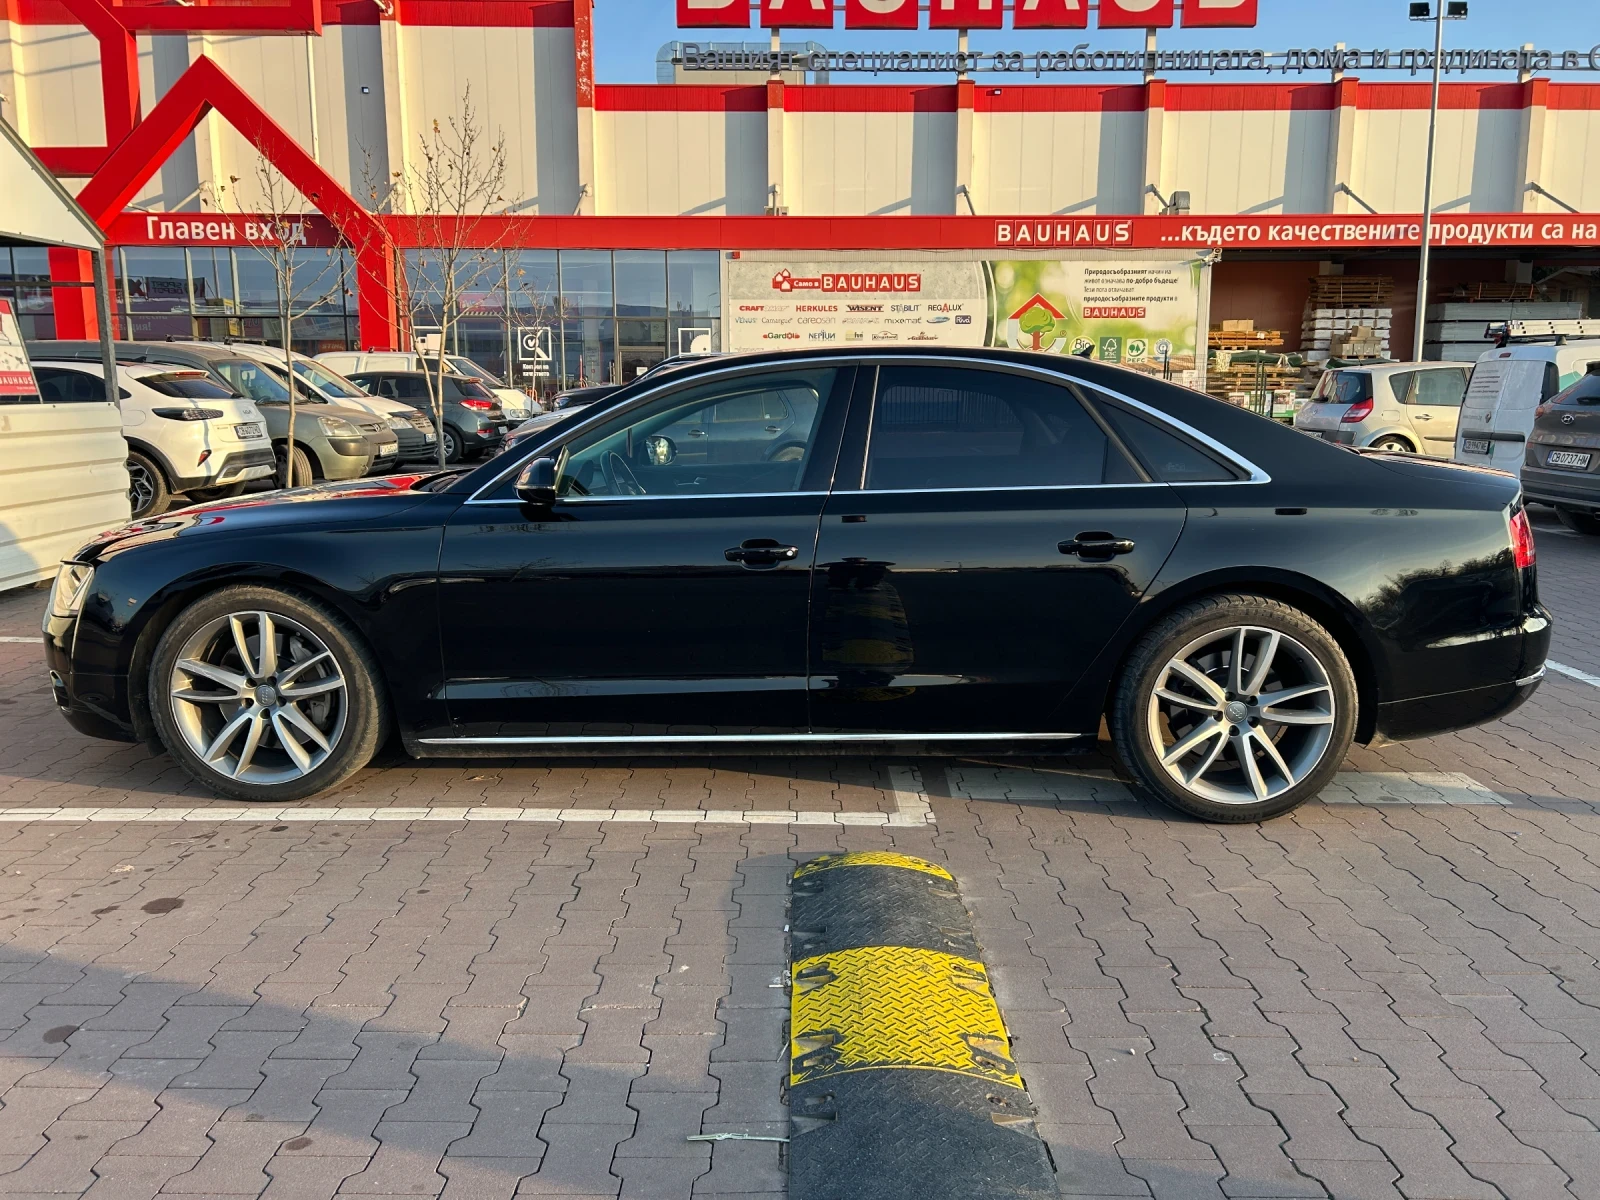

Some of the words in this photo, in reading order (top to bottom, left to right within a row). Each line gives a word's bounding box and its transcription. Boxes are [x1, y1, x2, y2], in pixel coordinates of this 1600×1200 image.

[682, 43, 797, 71] Вашият
[808, 50, 982, 77] специалист
[992, 51, 1024, 71] за
[1036, 43, 1273, 78] работилницата,
[1282, 48, 1362, 74] дома
[1373, 49, 1390, 69] и
[1401, 48, 1553, 76] градината
[1563, 50, 1580, 70] в
[146, 216, 236, 241] Главен
[996, 223, 1132, 243] BAUHAUS
[1161, 222, 1261, 245] ...където
[1268, 223, 1420, 241] качествените
[1429, 222, 1534, 245] продукти
[1541, 223, 1564, 240] са
[1571, 223, 1598, 240] на
[1084, 268, 1147, 276] Природосъобразният
[822, 275, 920, 291] BAUHAUS
[1126, 277, 1153, 285] по-добро
[1084, 295, 1145, 303] природосъобразните
[796, 304, 838, 312] HERKULES
[928, 303, 962, 312] REGALUX
[1084, 307, 1145, 318] BAUHAUS
